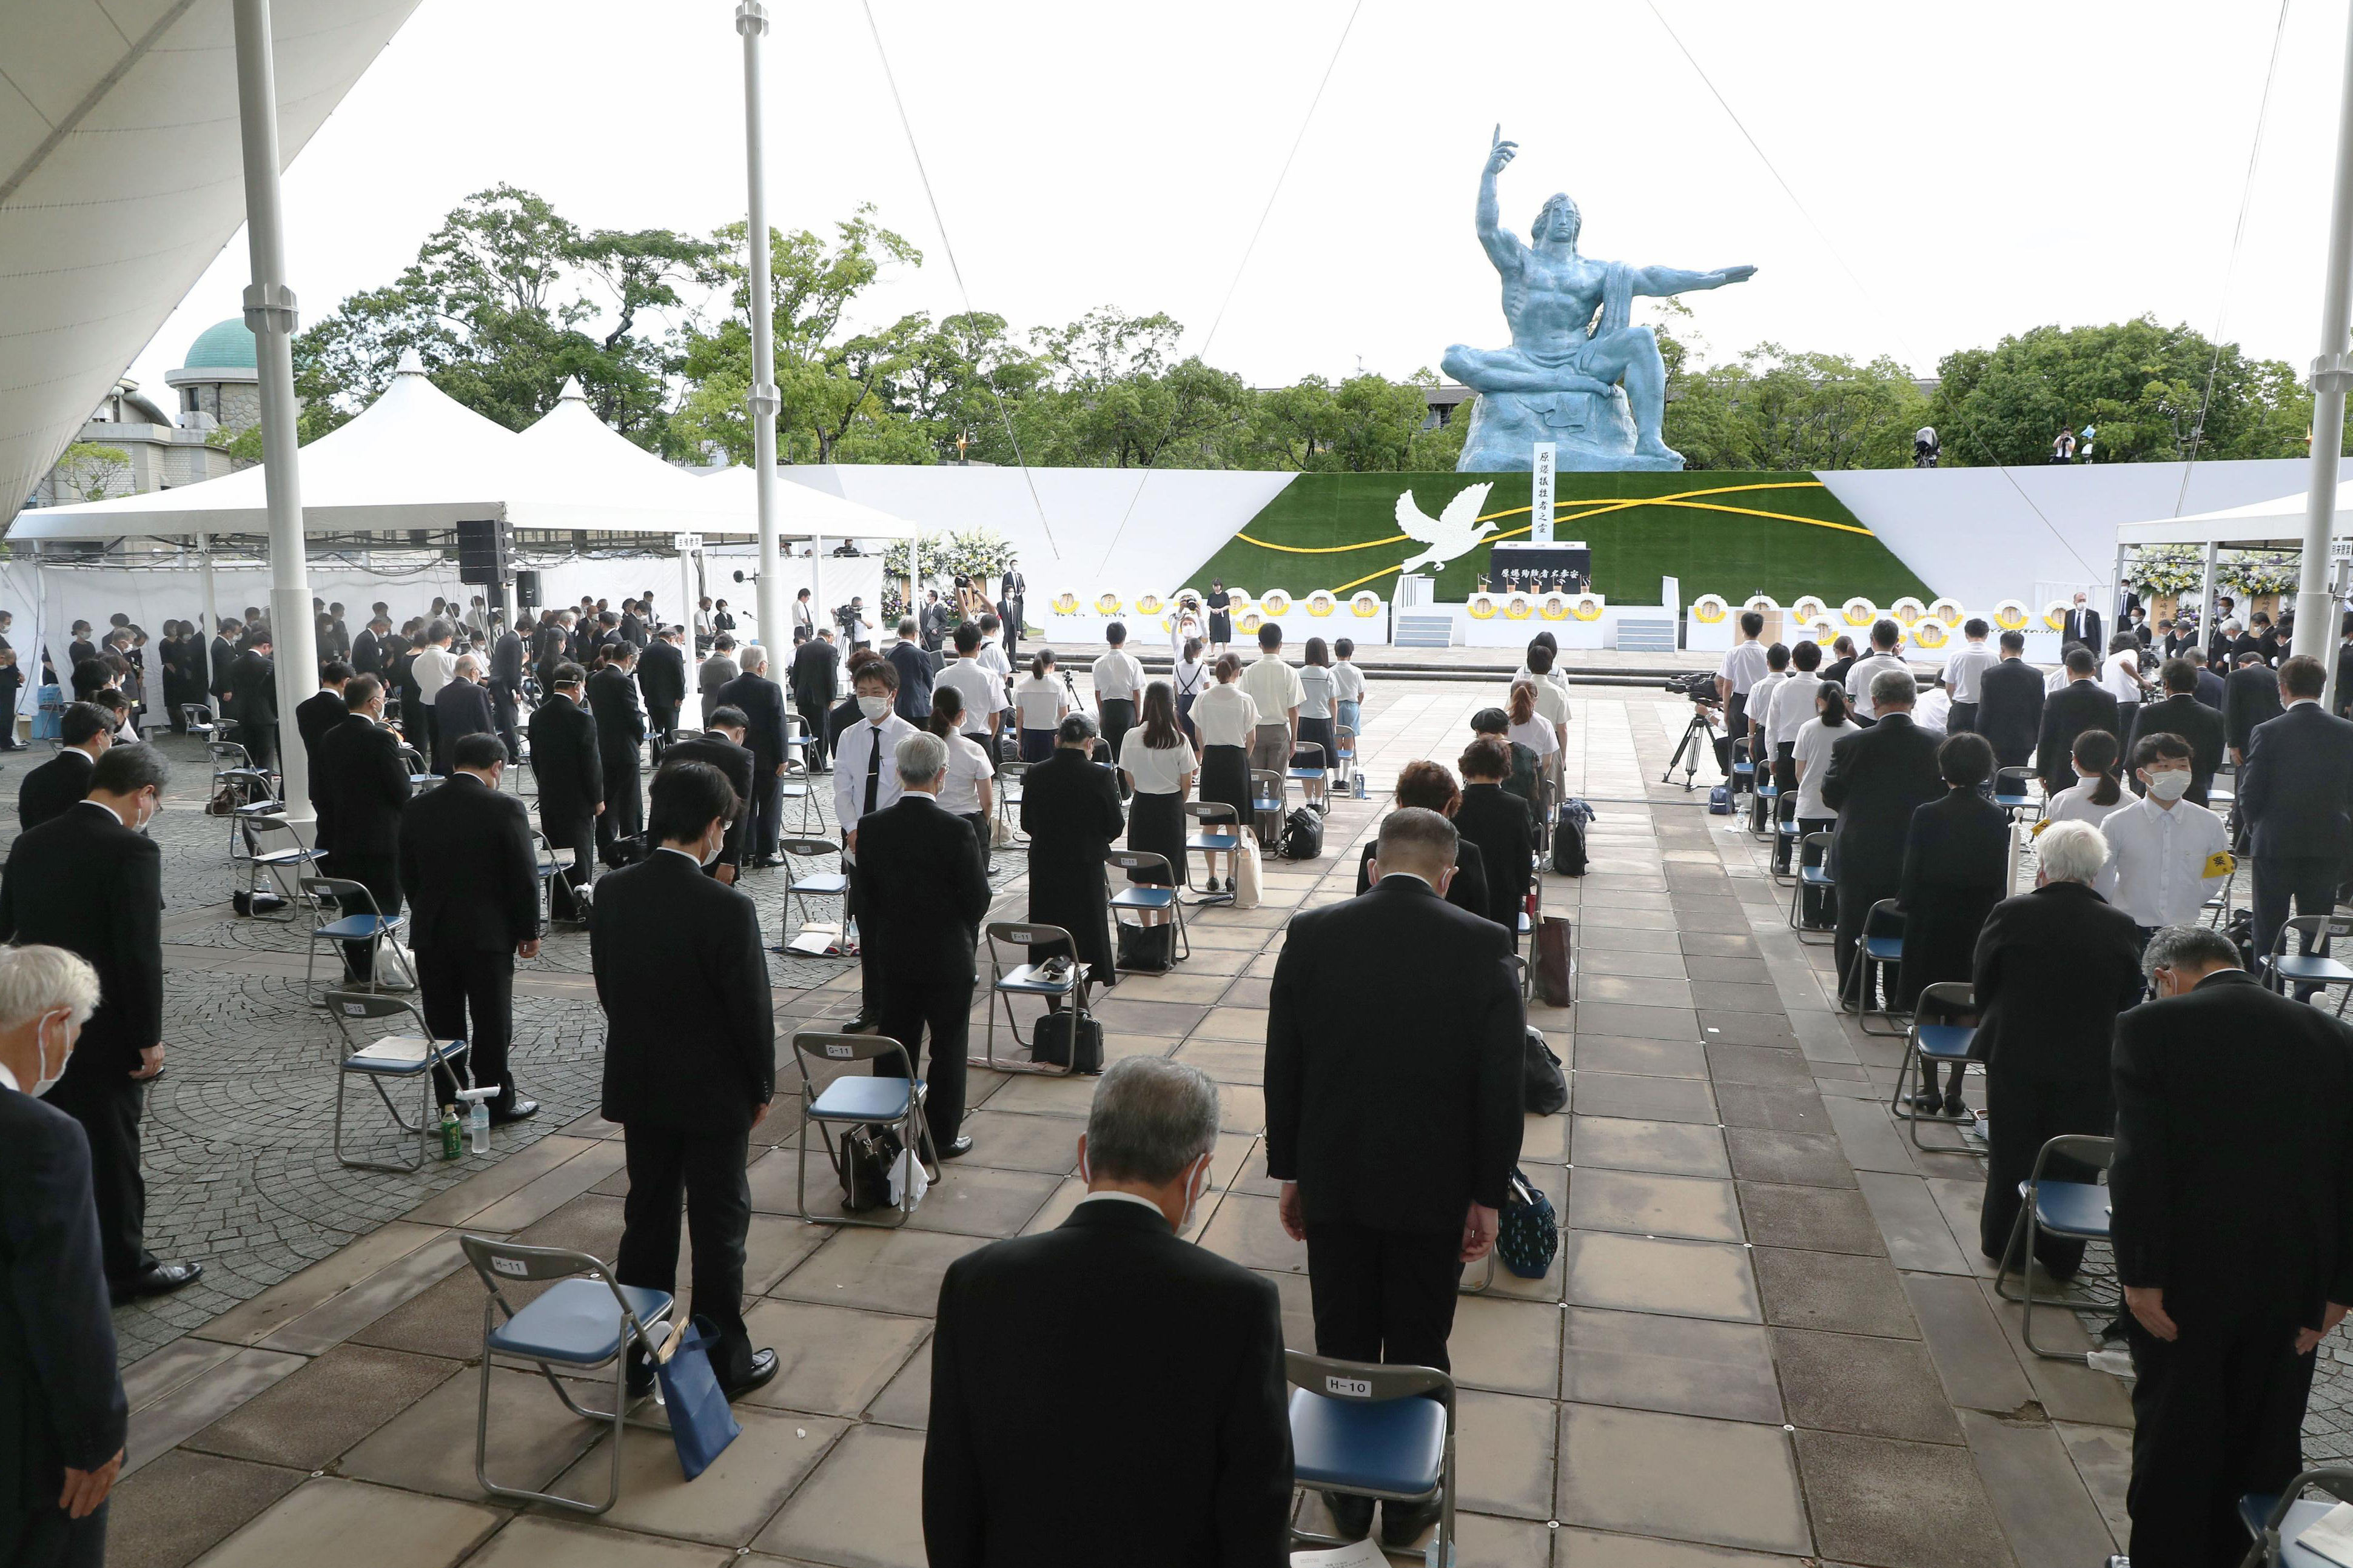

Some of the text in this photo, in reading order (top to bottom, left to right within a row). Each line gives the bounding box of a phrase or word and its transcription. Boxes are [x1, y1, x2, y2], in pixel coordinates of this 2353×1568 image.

[2212, 856, 2225, 867] 案
[828, 1046, 849, 1054] G-11
[495, 1259, 521, 1271] H-11
[1331, 1379, 1366, 1393] H-10
